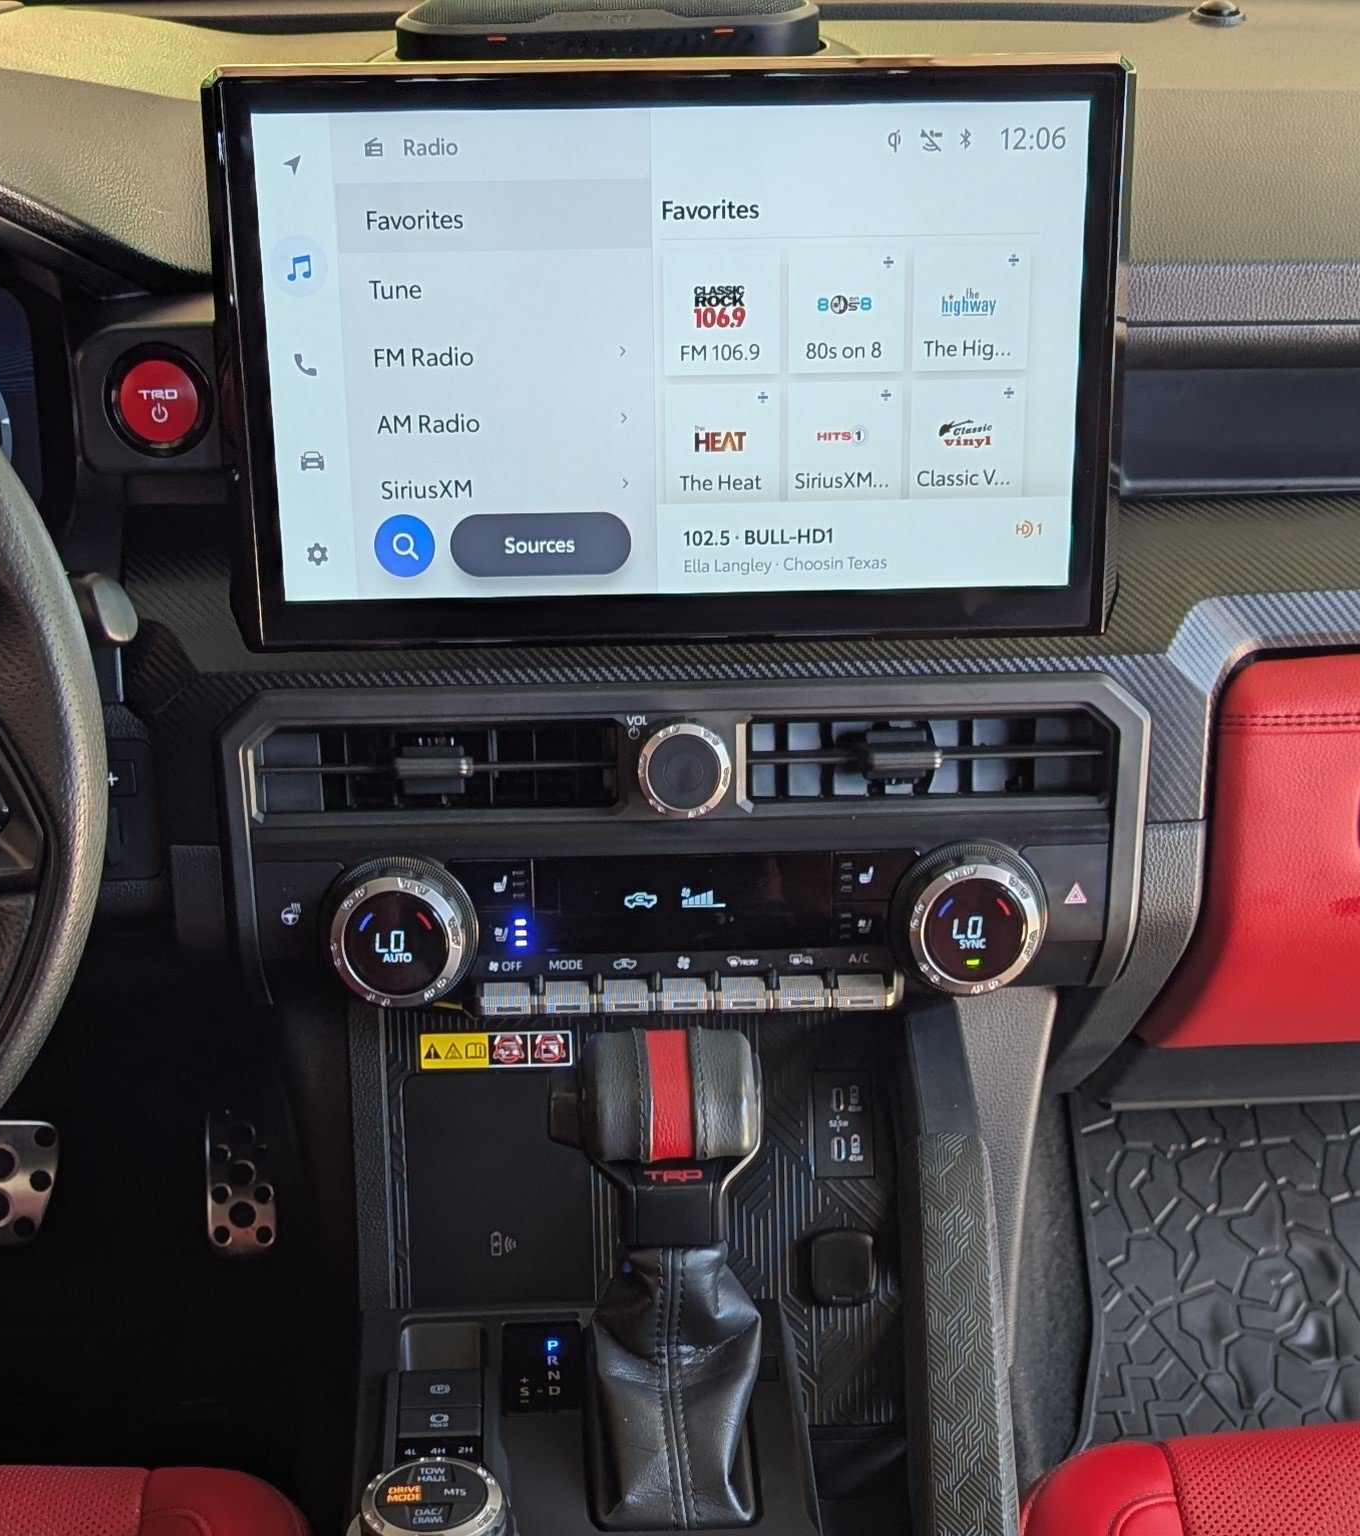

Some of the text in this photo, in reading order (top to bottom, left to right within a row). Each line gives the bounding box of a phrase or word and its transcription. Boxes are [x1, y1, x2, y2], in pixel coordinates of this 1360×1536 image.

[1000, 126, 1067, 151] 12:06
[402, 137, 459, 157] Radio
[661, 199, 760, 221] Favorites
[366, 210, 464, 231] Favorites
[368, 280, 423, 300] Tune
[693, 285, 745, 296] CLASSIC
[965, 287, 979, 299] the
[694, 295, 746, 308] ROCK
[941, 293, 997, 317] highway
[693, 307, 746, 328] 106.9
[680, 343, 761, 362] FM 106.9
[805, 341, 882, 360] 80s on 8
[923, 339, 1011, 361] The Hig...
[374, 347, 474, 368] FM Radio
[138, 388, 179, 401] TRD
[377, 413, 480, 434] AM Radio
[953, 423, 993, 436] Classic
[694, 431, 747, 453] HEAT
[816, 431, 852, 441] HITS
[943, 435, 992, 448] vinyl
[679, 474, 762, 491] The Heat
[794, 472, 889, 490] SiriusXM...
[916, 469, 1011, 488] Classic V...
[380, 480, 473, 500] SiriusXM
[683, 527, 834, 547] 102.5 BULL-HD1
[504, 536, 576, 554] Sources
[683, 556, 888, 576] Ella Langley Choosin Texas
[626, 715, 648, 726] VOL
[952, 915, 984, 940] LO
[374, 930, 405, 953] LO
[959, 937, 987, 950] SYNC
[382, 952, 413, 963] AUTO
[848, 952, 870, 964] A/C
[501, 960, 523, 972] OFF
[548, 959, 584, 971] MODE
[643, 1169, 703, 1182] TRD
[547, 1340, 559, 1351] P
[547, 1355, 559, 1366] R
[548, 1370, 561, 1381] N
[520, 1385, 561, 1397] S D
[404, 1448, 417, 1456] 4L
[430, 1447, 446, 1455] 4H
[458, 1446, 474, 1454] 2H
[419, 1467, 446, 1475] TOW
[388, 1485, 422, 1494] DRIVE
[443, 1488, 467, 1496] MTS
[386, 1493, 422, 1503] MODE
